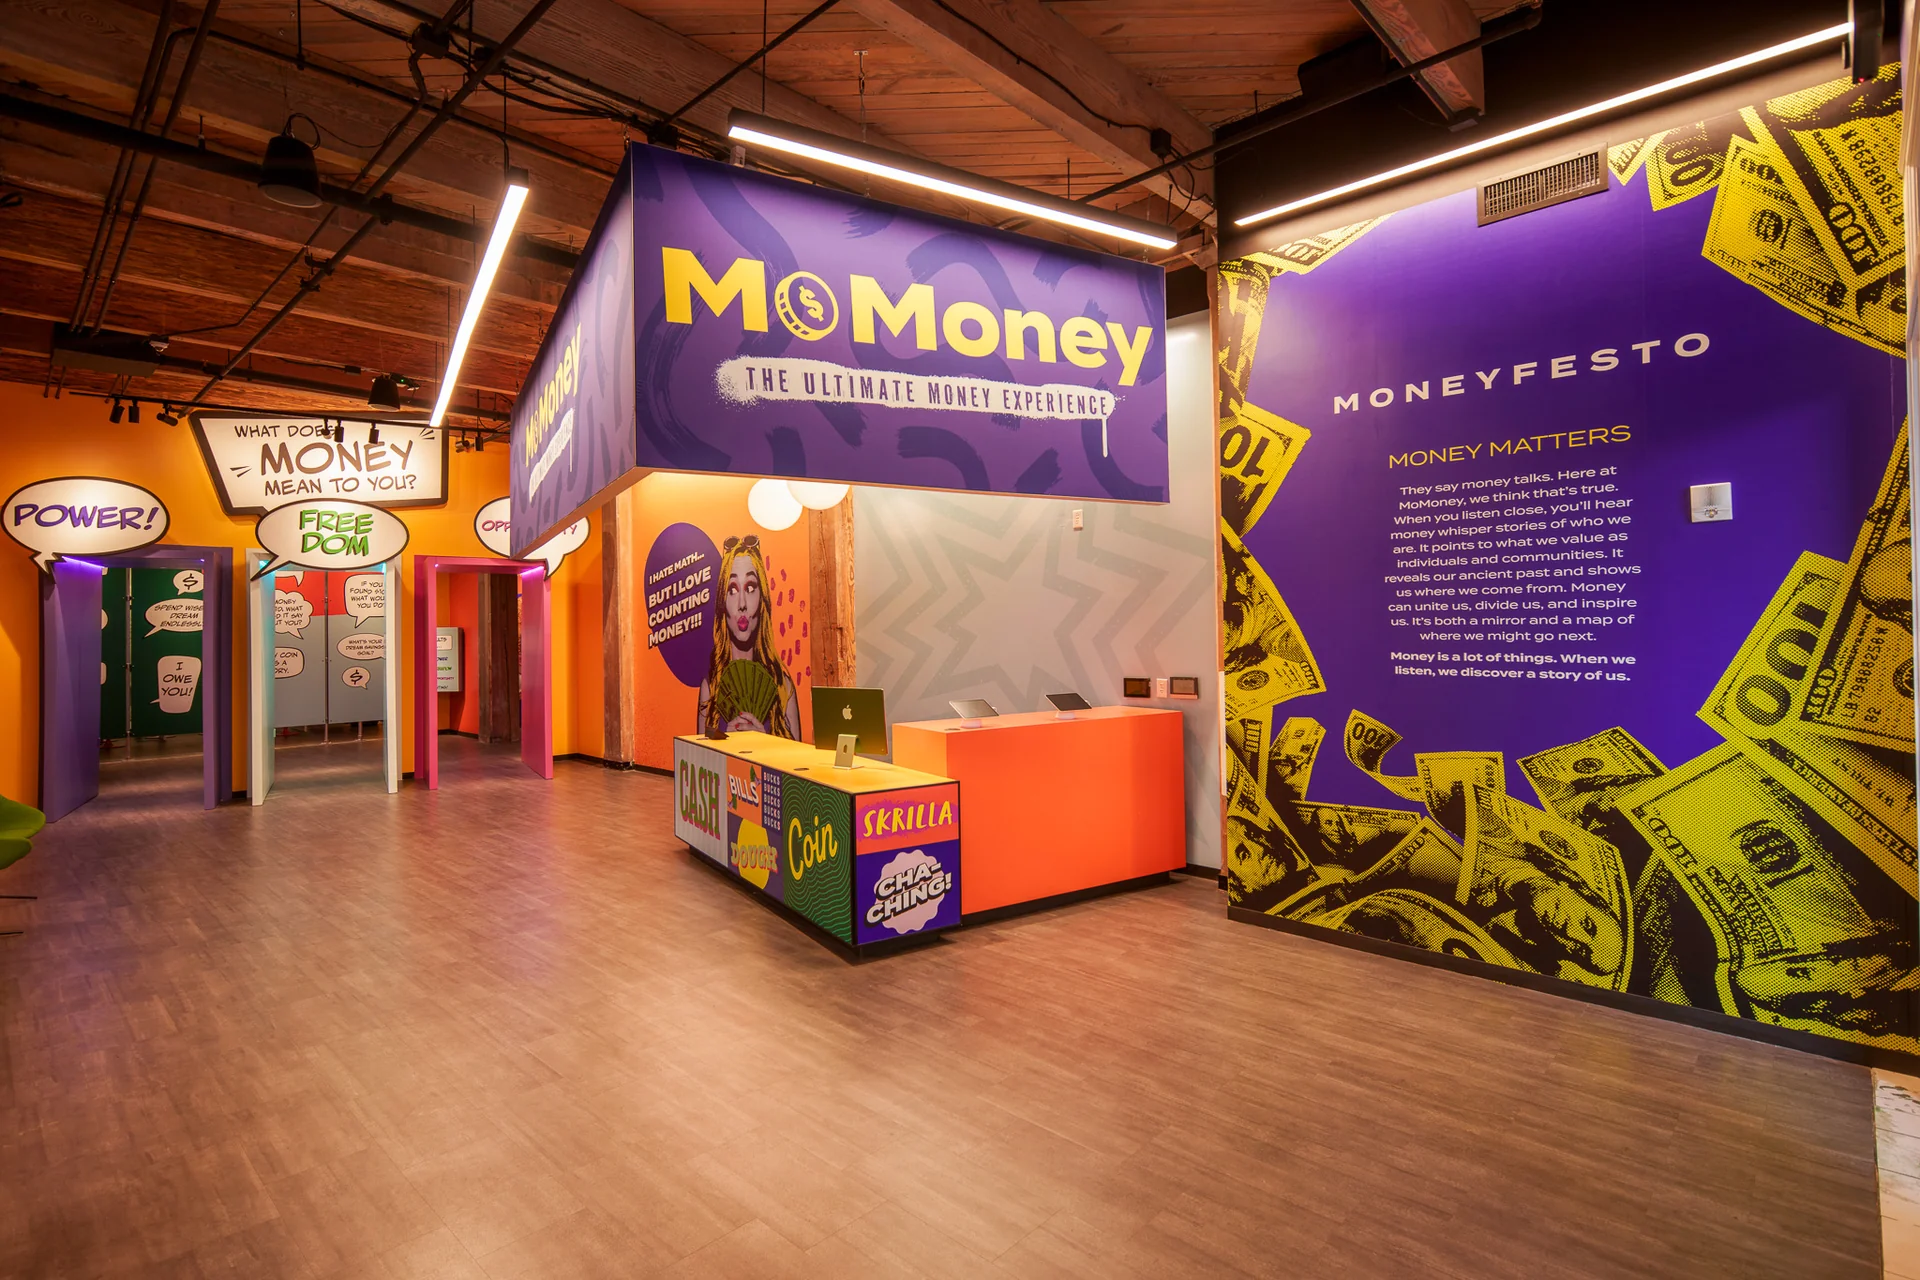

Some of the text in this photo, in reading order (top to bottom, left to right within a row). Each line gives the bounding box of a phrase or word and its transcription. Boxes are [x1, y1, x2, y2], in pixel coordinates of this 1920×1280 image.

[1333, 332, 1710, 415] MONEYFESTO
[746, 366, 1108, 416] THE ULTIMATE MONEY EXPERIENCE
[234, 425, 281, 438] WHAT
[260, 439, 413, 476] MONEY
[1388, 424, 1632, 469] MONEY MATTERS
[265, 474, 417, 497] MEAN TO YOU?
[1399, 466, 1617, 495] They say money talks. Here at
[1399, 498, 1467, 510] MoMoney,
[1469, 495, 1490, 504] we
[1492, 490, 1530, 502] think
[1581, 484, 1618, 494] true.
[14, 504, 160, 530] POWER!
[299, 509, 374, 534] FREE
[1394, 515, 1431, 525] When
[1434, 513, 1459, 524] you
[1462, 510, 1500, 520] listen
[1504, 506, 1547, 516] close,
[1595, 499, 1633, 509] hear
[1390, 516, 1631, 540] money whisper stories of who we
[301, 532, 370, 557] DOM
[1393, 533, 1628, 554] are. It points to what we value as
[649, 551, 705, 585] I HATE MATH...
[1397, 548, 1623, 568] individuals and communities. It
[1385, 565, 1641, 583] reveals our ancient past and shows
[648, 566, 711, 609] BUT I LOVE
[1396, 583, 1626, 597] us where we come from. Money
[154, 604, 183, 612] SPEND
[648, 588, 710, 628] COUNTING
[1388, 598, 1637, 612] can unite us, divide us, and inspire
[648, 612, 702, 649] MONEY!!!
[1391, 618, 1409, 626] us.
[1434, 616, 1466, 626] both
[1482, 616, 1526, 625] mirror
[1529, 615, 1558, 625] and
[1562, 617, 1572, 625] a
[1576, 616, 1613, 626] map
[1617, 614, 1635, 624] of
[1419, 632, 1461, 640] where
[1488, 631, 1531, 643] might
[1534, 633, 1554, 643] go
[1558, 632, 1597, 641] next.
[1391, 652, 1435, 663] Money
[1437, 652, 1450, 661] is
[1463, 652, 1483, 662] lot
[1485, 653, 1502, 662] of
[1503, 652, 1557, 665] things.
[1560, 654, 1608, 664] When
[1611, 656, 1636, 664] we
[163, 673, 193, 683] OWE
[1395, 665, 1436, 677] listen,
[1460, 667, 1524, 678] discover
[1539, 670, 1582, 682] story
[1584, 670, 1603, 680] of
[1605, 673, 1631, 681] us.
[161, 687, 193, 697] YOU!
[728, 774, 759, 807] BILLS
[763, 771, 780, 785] BUCKS
[763, 782, 780, 797] BUCKS
[680, 759, 721, 841] CASH
[763, 794, 780, 808] BUCKS
[763, 805, 780, 820] BUCKS
[763, 817, 780, 831] BUCKS
[863, 801, 952, 838] SKRILLA
[730, 841, 779, 874] DOUGH
[788, 815, 838, 881] Coin
[877, 862, 942, 900] CHA-
[864, 872, 952, 928] CHING!
